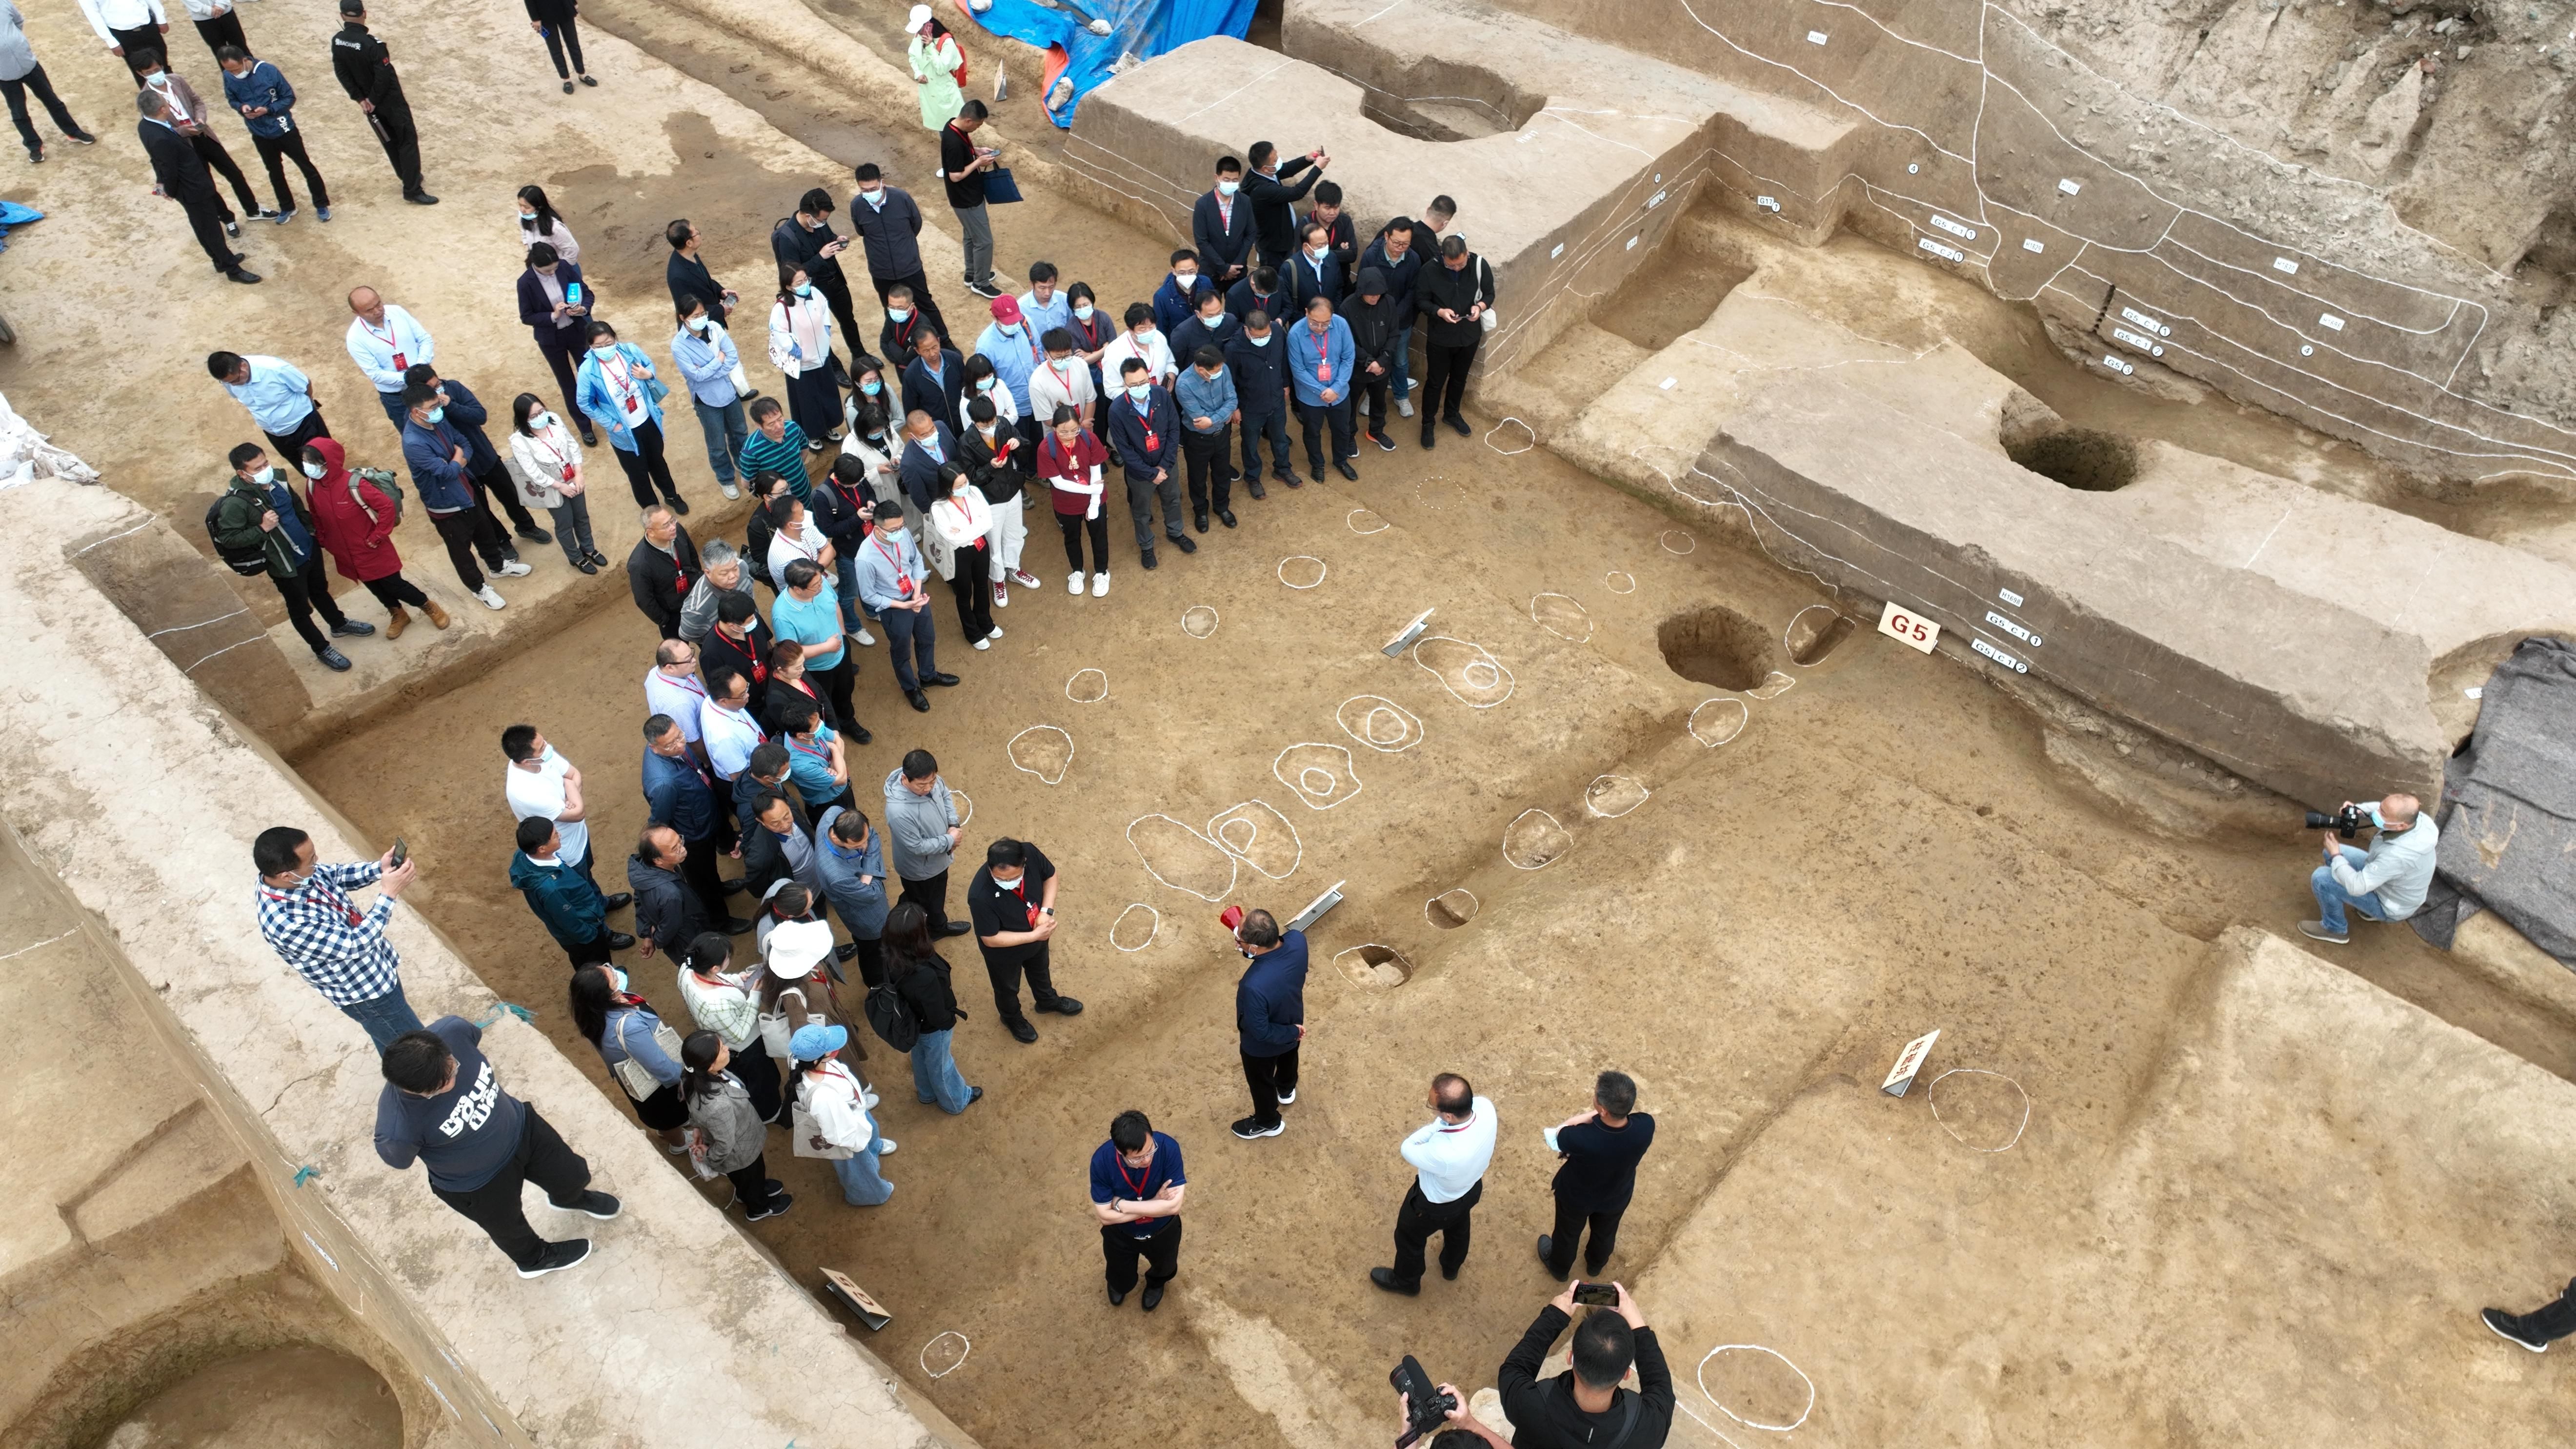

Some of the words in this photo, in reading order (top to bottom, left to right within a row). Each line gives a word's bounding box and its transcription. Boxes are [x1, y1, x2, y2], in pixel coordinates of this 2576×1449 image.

[1935, 219, 1946, 227] G5
[1923, 242, 1935, 250] G5
[2126, 312, 2138, 321] G5
[2117, 332, 2130, 341] G5
[2108, 359, 2120, 368] G5
[2002, 591, 2021, 605] H1698
[1990, 616, 2005, 627] G5
[1892, 615, 1929, 642] G5
[1976, 643, 1991, 655] G5
[834, 1276, 874, 1306] G5
